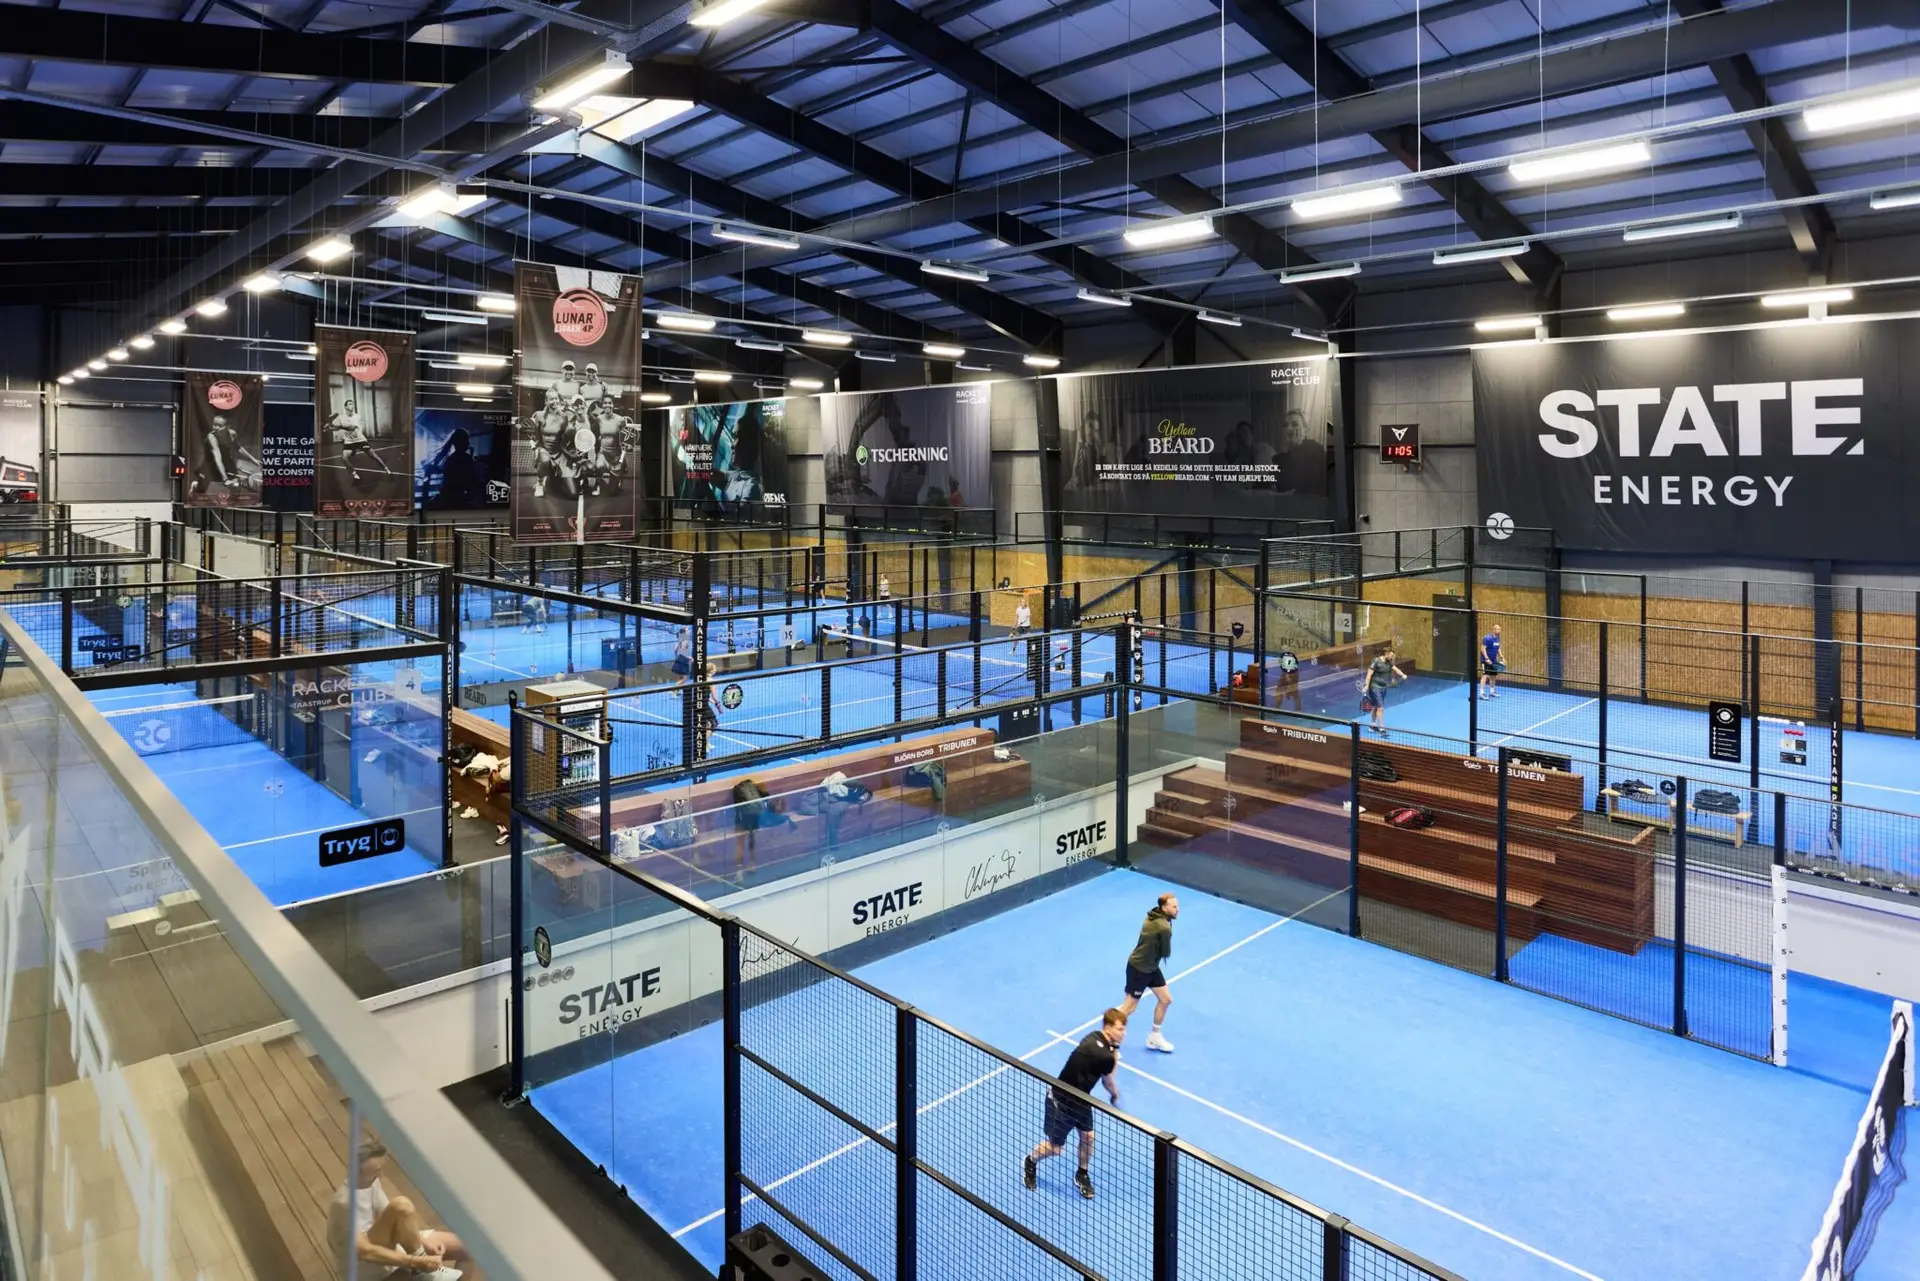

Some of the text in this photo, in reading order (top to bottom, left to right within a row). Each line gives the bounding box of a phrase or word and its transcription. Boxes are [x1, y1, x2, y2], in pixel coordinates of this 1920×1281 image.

[556, 313, 593, 324] LUNAR
[347, 358, 377, 367] LUNAR
[1271, 367, 1311, 378] RACKET
[1293, 376, 1320, 385] CLUB
[1538, 378, 1864, 459] STATE
[1158, 419, 1196, 439] Yellow
[871, 447, 948, 462] TSCHERNING
[1148, 438, 1214, 454] BEARD
[1142, 472, 1150, 480] PÅ
[1145, 463, 1152, 471] SÅ
[1215, 464, 1240, 472] BILLEDE
[1594, 475, 1794, 506] ENERGY
[80, 639, 106, 648] Tryg
[95, 651, 122, 660] Tryg
[464, 687, 487, 706] BEARD
[1281, 728, 1327, 743] TRIBUNEN
[894, 737, 977, 763] BJÖRN BORG TRIBUNEN
[1488, 764, 1545, 781] TRBUNEN
[324, 836, 371, 855] Tryg
[1056, 820, 1106, 855] STATE
[1066, 847, 1097, 865] ENERGY
[853, 881, 922, 925] STATE
[866, 914, 910, 938] ENERGY
[559, 966, 660, 1024] STATE
